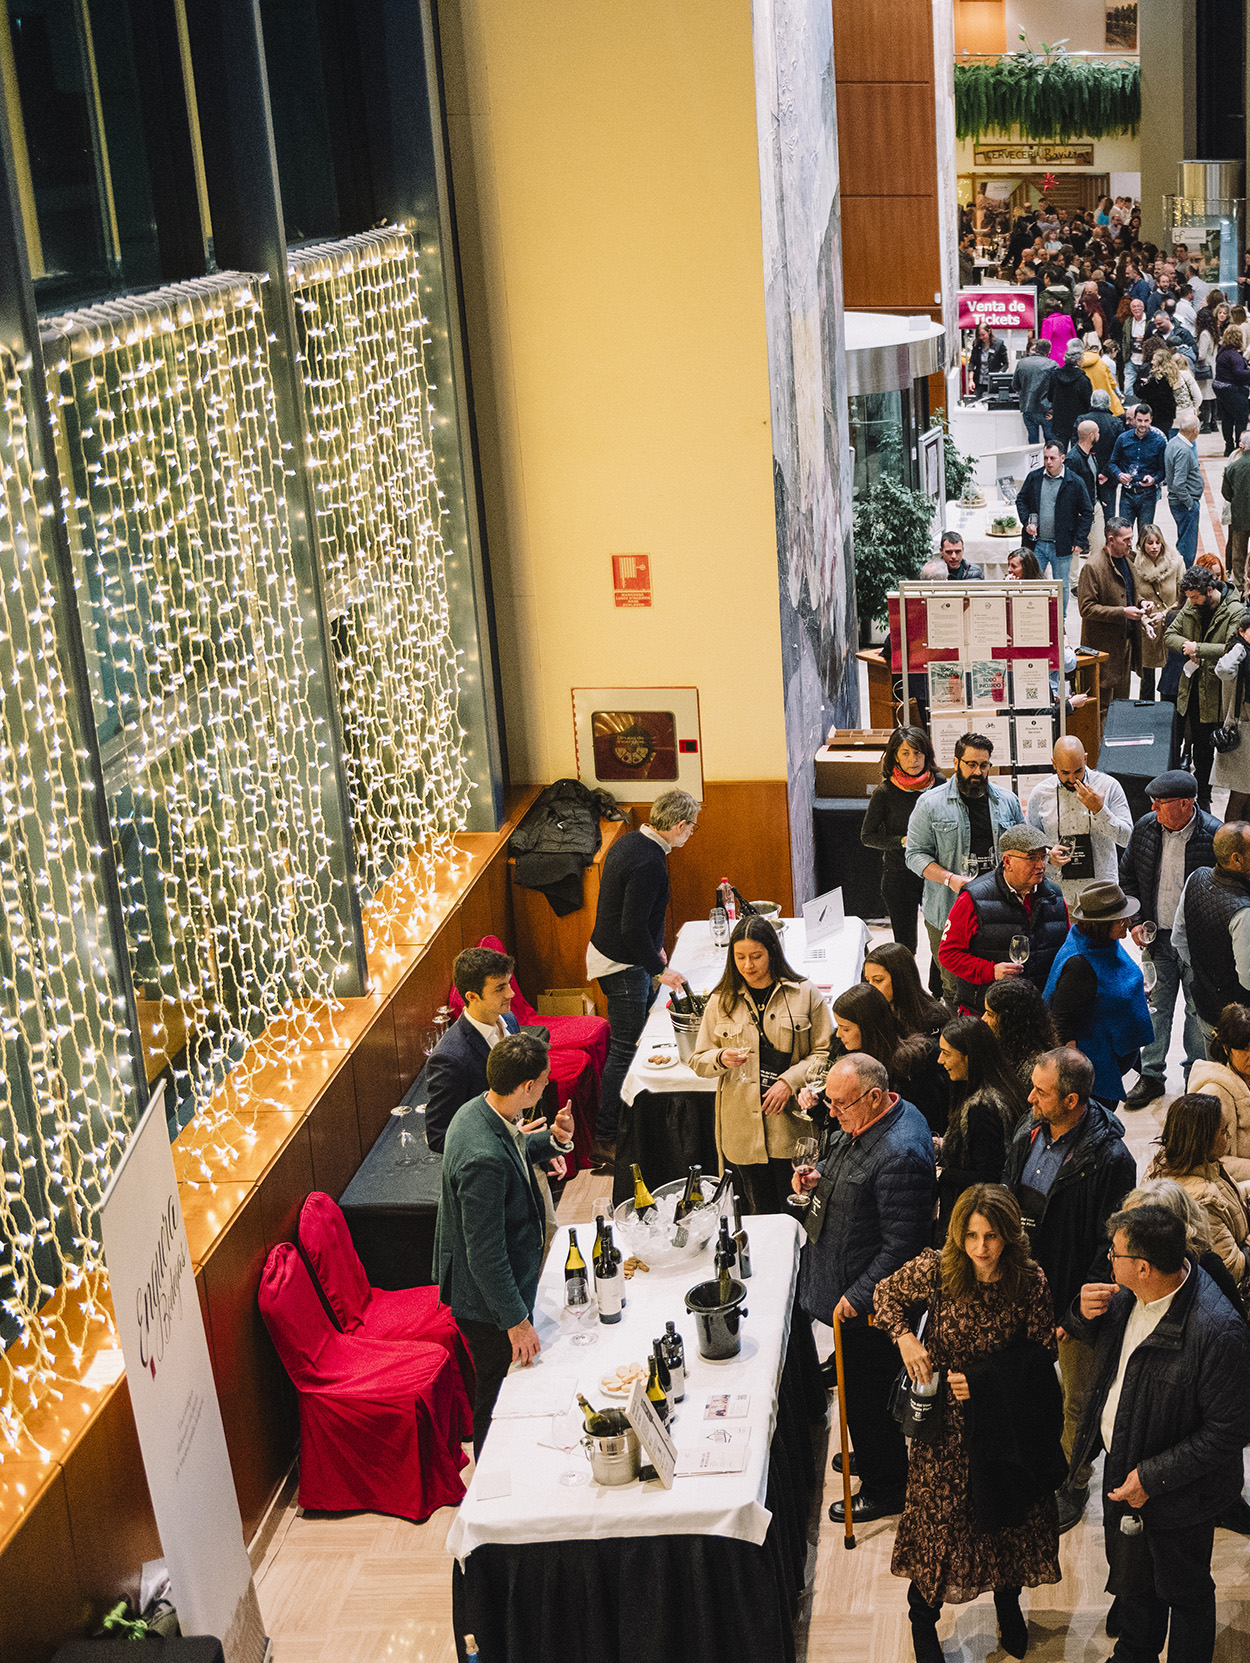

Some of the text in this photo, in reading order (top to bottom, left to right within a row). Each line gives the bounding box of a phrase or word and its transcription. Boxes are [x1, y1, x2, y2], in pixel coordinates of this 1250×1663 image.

[967, 300, 1026, 312] Venta de
[972, 313, 1021, 325] Tickets
